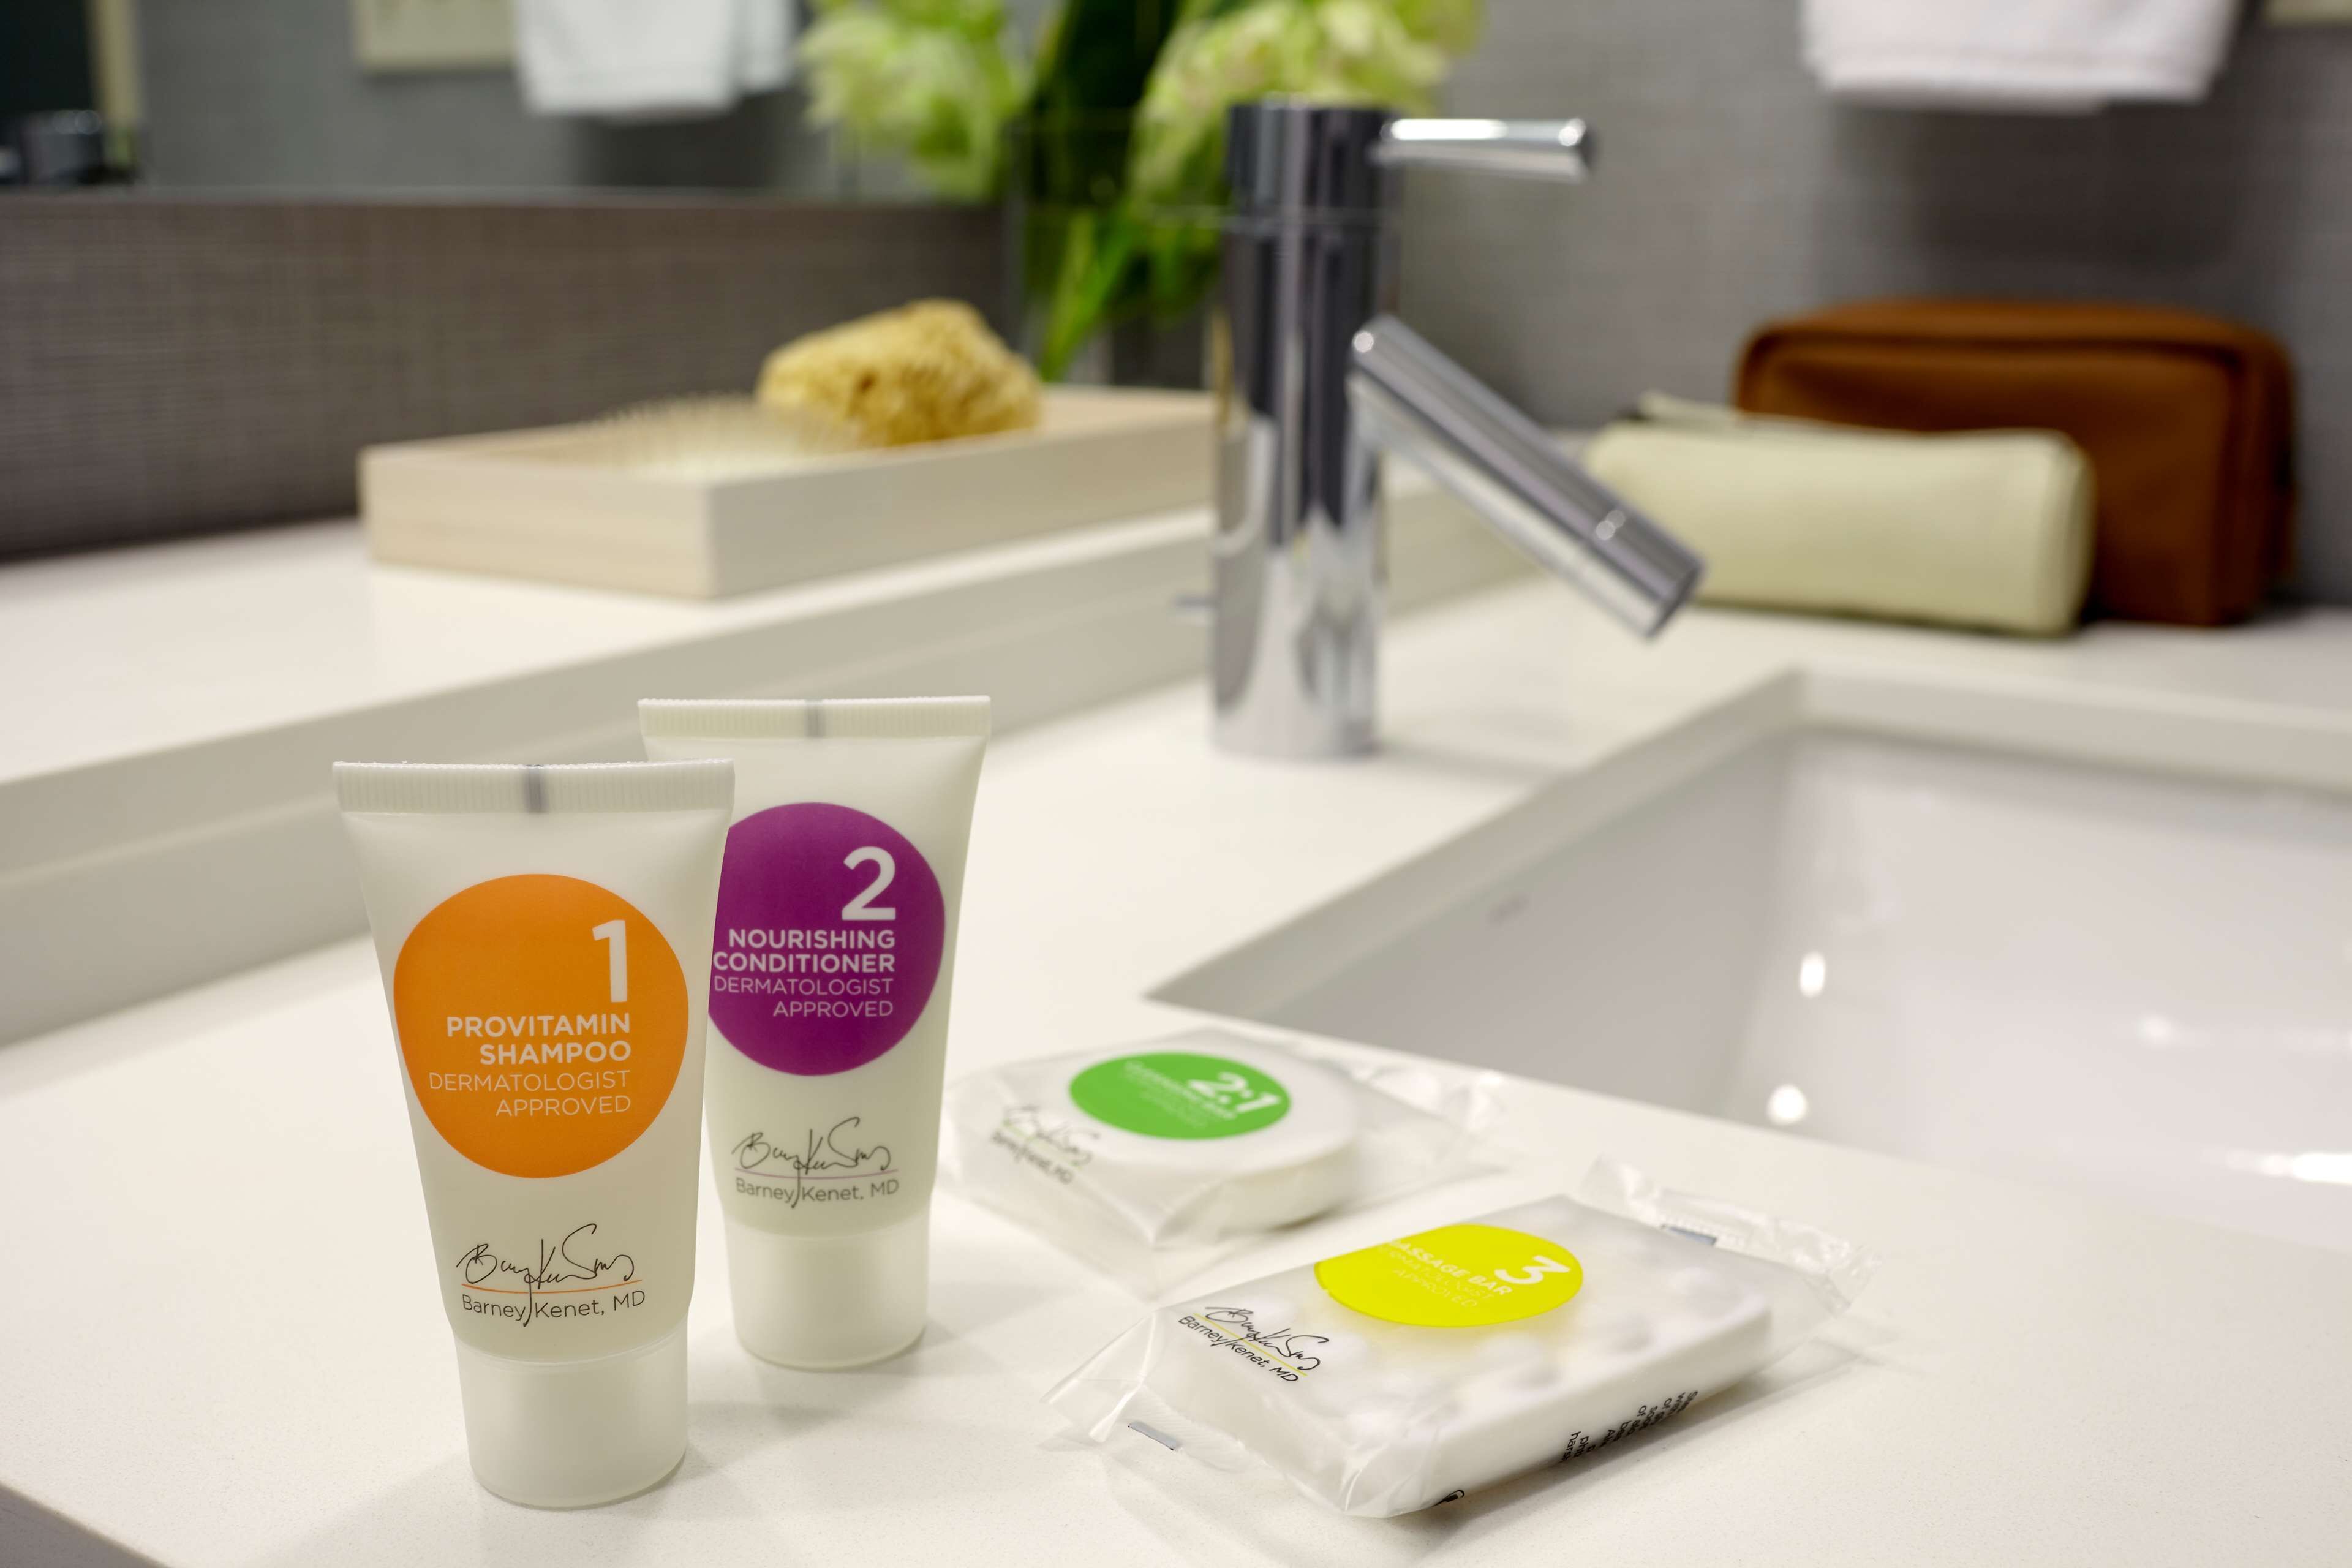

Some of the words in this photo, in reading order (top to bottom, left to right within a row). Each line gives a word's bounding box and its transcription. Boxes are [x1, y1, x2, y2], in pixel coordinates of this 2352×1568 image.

[842, 846, 896, 921] 2
[728, 929, 895, 949] NOURISHING
[592, 919, 628, 1003] 1
[712, 951, 895, 973] CONDITIONER
[714, 975, 894, 995] DERMATOLOGIST
[772, 1000, 894, 1017] APPROVED
[447, 1012, 630, 1038] PROVITAMIN
[479, 1040, 631, 1065] SHAMPOO
[428, 1069, 631, 1092] DERMATOLOGIST
[1188, 1071, 1281, 1114] 2:1
[495, 1095, 631, 1117] APPROVED
[735, 1177, 794, 1203] Barney
[870, 1178, 900, 1197] MD
[1494, 1254, 1571, 1285] 3
[1468, 1275, 1513, 1295] BAR
[462, 1294, 526, 1321] Barney
[534, 1299, 605, 1319] Kenet,
[612, 1290, 646, 1311] MD
[1178, 1316, 1227, 1343] Barney
[1226, 1341, 1270, 1368] Kenet,
[1269, 1366, 1300, 1382] MD
